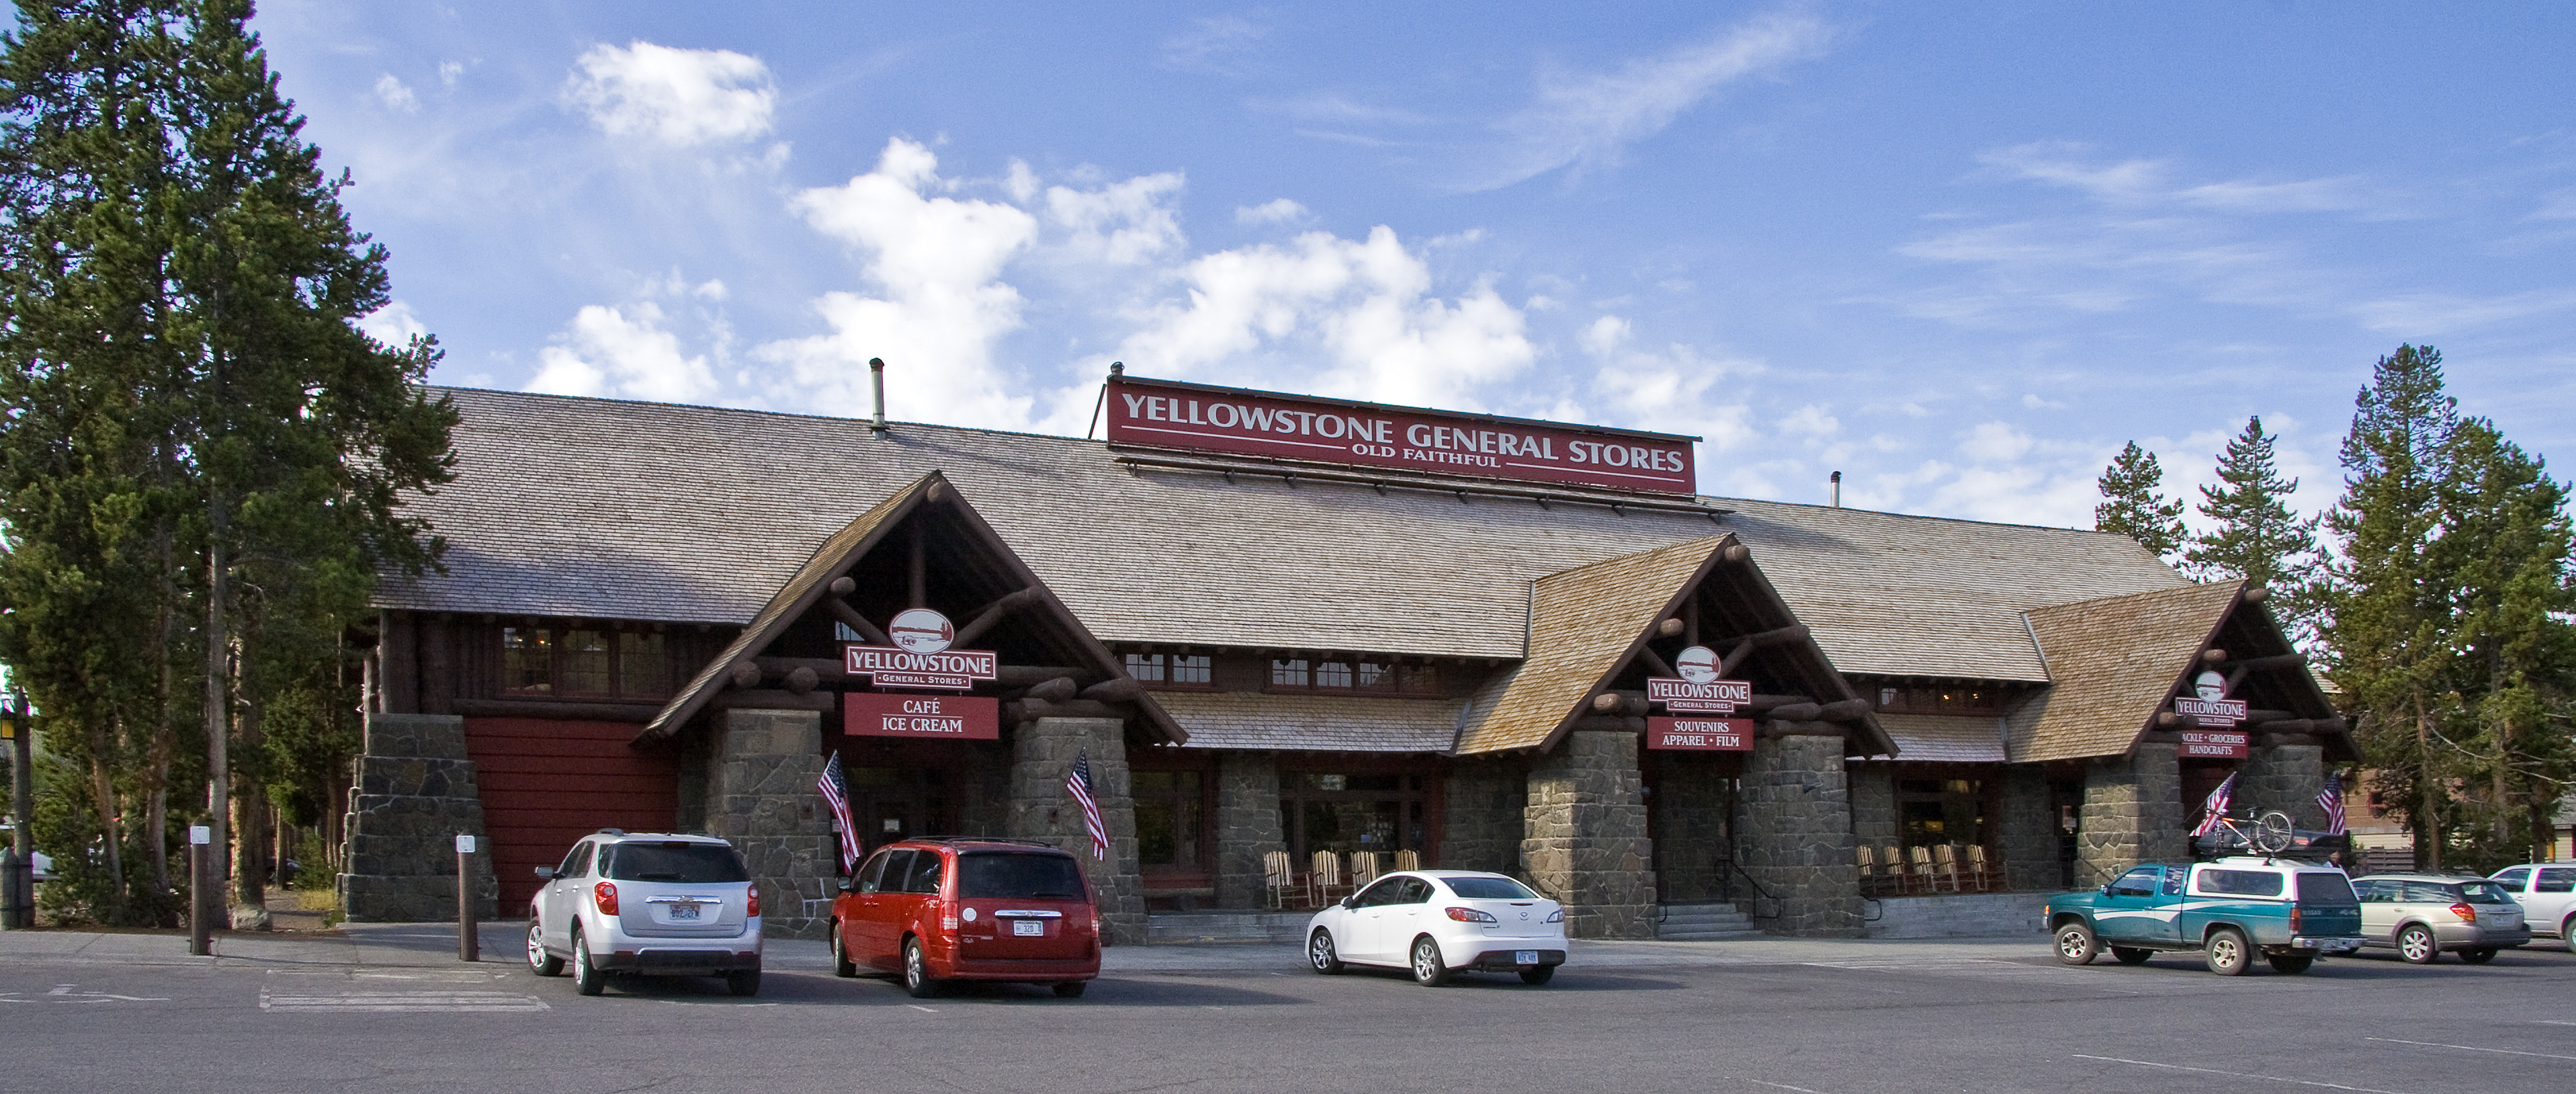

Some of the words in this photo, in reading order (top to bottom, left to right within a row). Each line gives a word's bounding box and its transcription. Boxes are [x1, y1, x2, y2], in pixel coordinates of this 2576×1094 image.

[1122, 392, 1393, 444] YELLOWSTONE
[1408, 423, 1559, 460] GENERAL
[1569, 440, 1684, 473] STORES
[1351, 444, 1396, 458] OLD
[1403, 448, 1501, 468] FAITHFUL
[852, 651, 991, 674] YELLOWSTONE
[882, 675, 925, 683] GENERAL
[928, 676, 963, 685] STORES
[1652, 683, 1747, 700] YELLOWSTONE
[903, 698, 941, 714] CAFÉ
[2178, 701, 2243, 716] YELLOWSTONE
[882, 717, 906, 731] ICE
[911, 718, 963, 732] CREAM
[1674, 721, 1729, 732] SOUVENIRS
[1662, 735, 1707, 746] APPAREL
[1716, 736, 1740, 747] FILM
[2208, 734, 2245, 743] GROCERIES
[2189, 745, 2233, 755] HANDCRAFTS
[1023, 925, 1034, 933] 320
